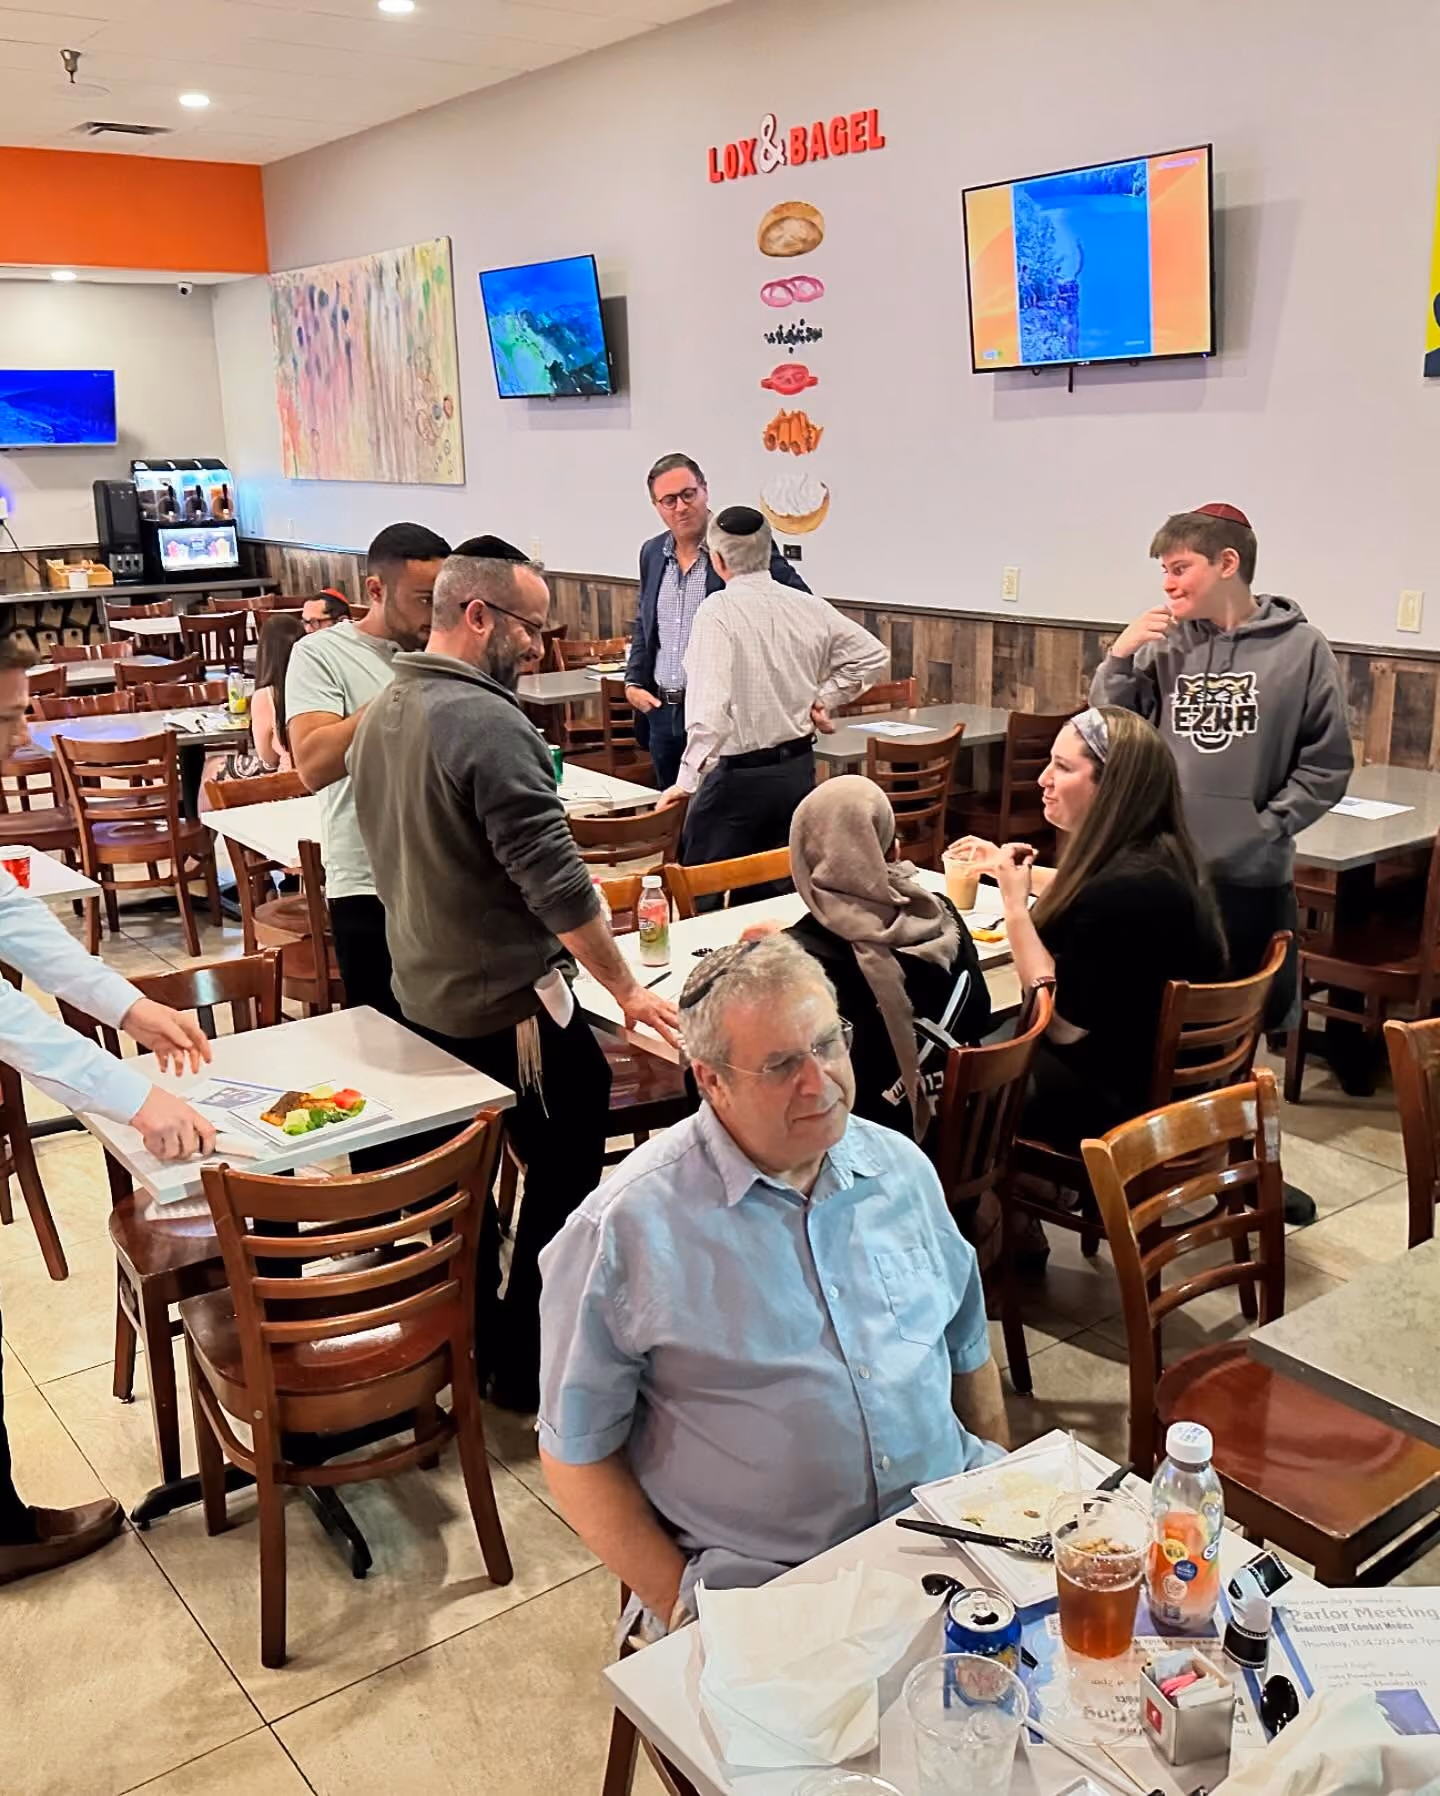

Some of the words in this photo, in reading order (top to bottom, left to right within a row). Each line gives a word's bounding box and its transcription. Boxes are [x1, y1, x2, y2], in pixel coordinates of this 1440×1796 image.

[708, 138, 757, 183] LOX
[790, 108, 885, 166] BAGEL
[1173, 704, 1257, 734] EZRA
[1290, 1607, 1349, 1622] Parlor
[1353, 1606, 1440, 1621] Meeting
